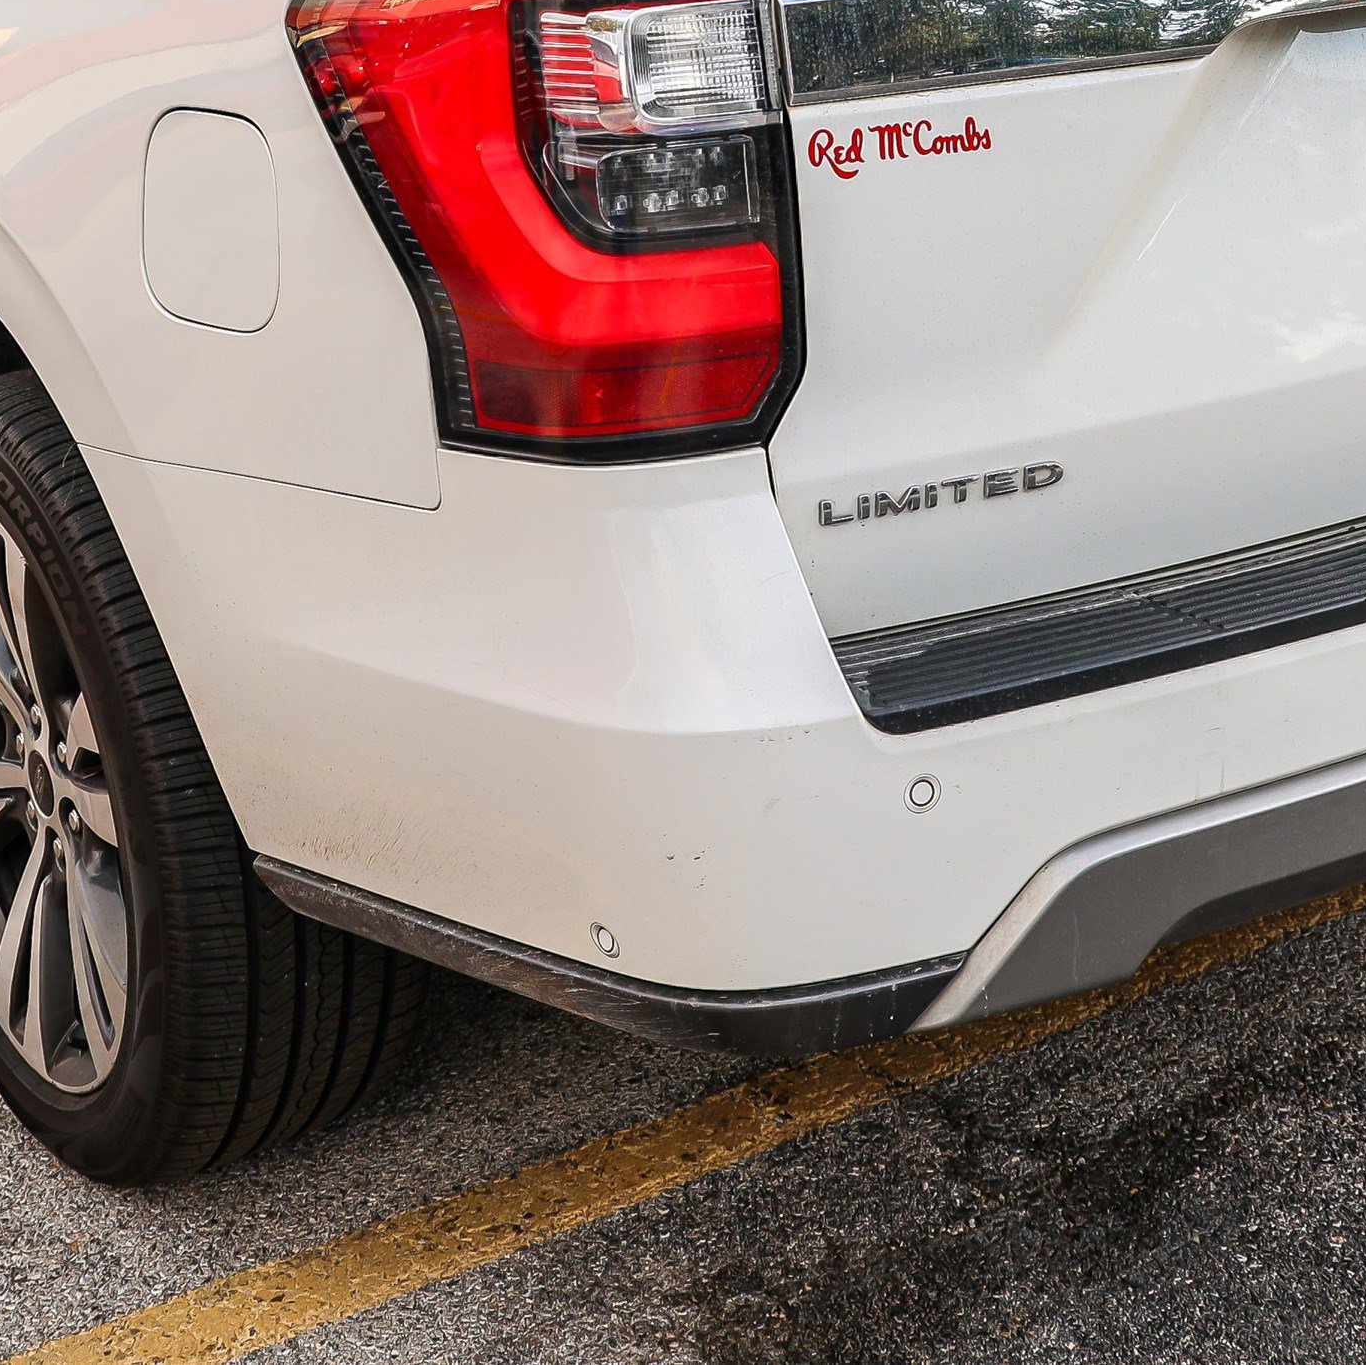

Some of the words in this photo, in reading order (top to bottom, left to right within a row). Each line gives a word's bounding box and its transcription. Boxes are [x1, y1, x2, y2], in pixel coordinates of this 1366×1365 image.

[808, 128, 865, 179] Red
[868, 117, 992, 160] McCombs
[818, 460, 1064, 526] LIMITED
